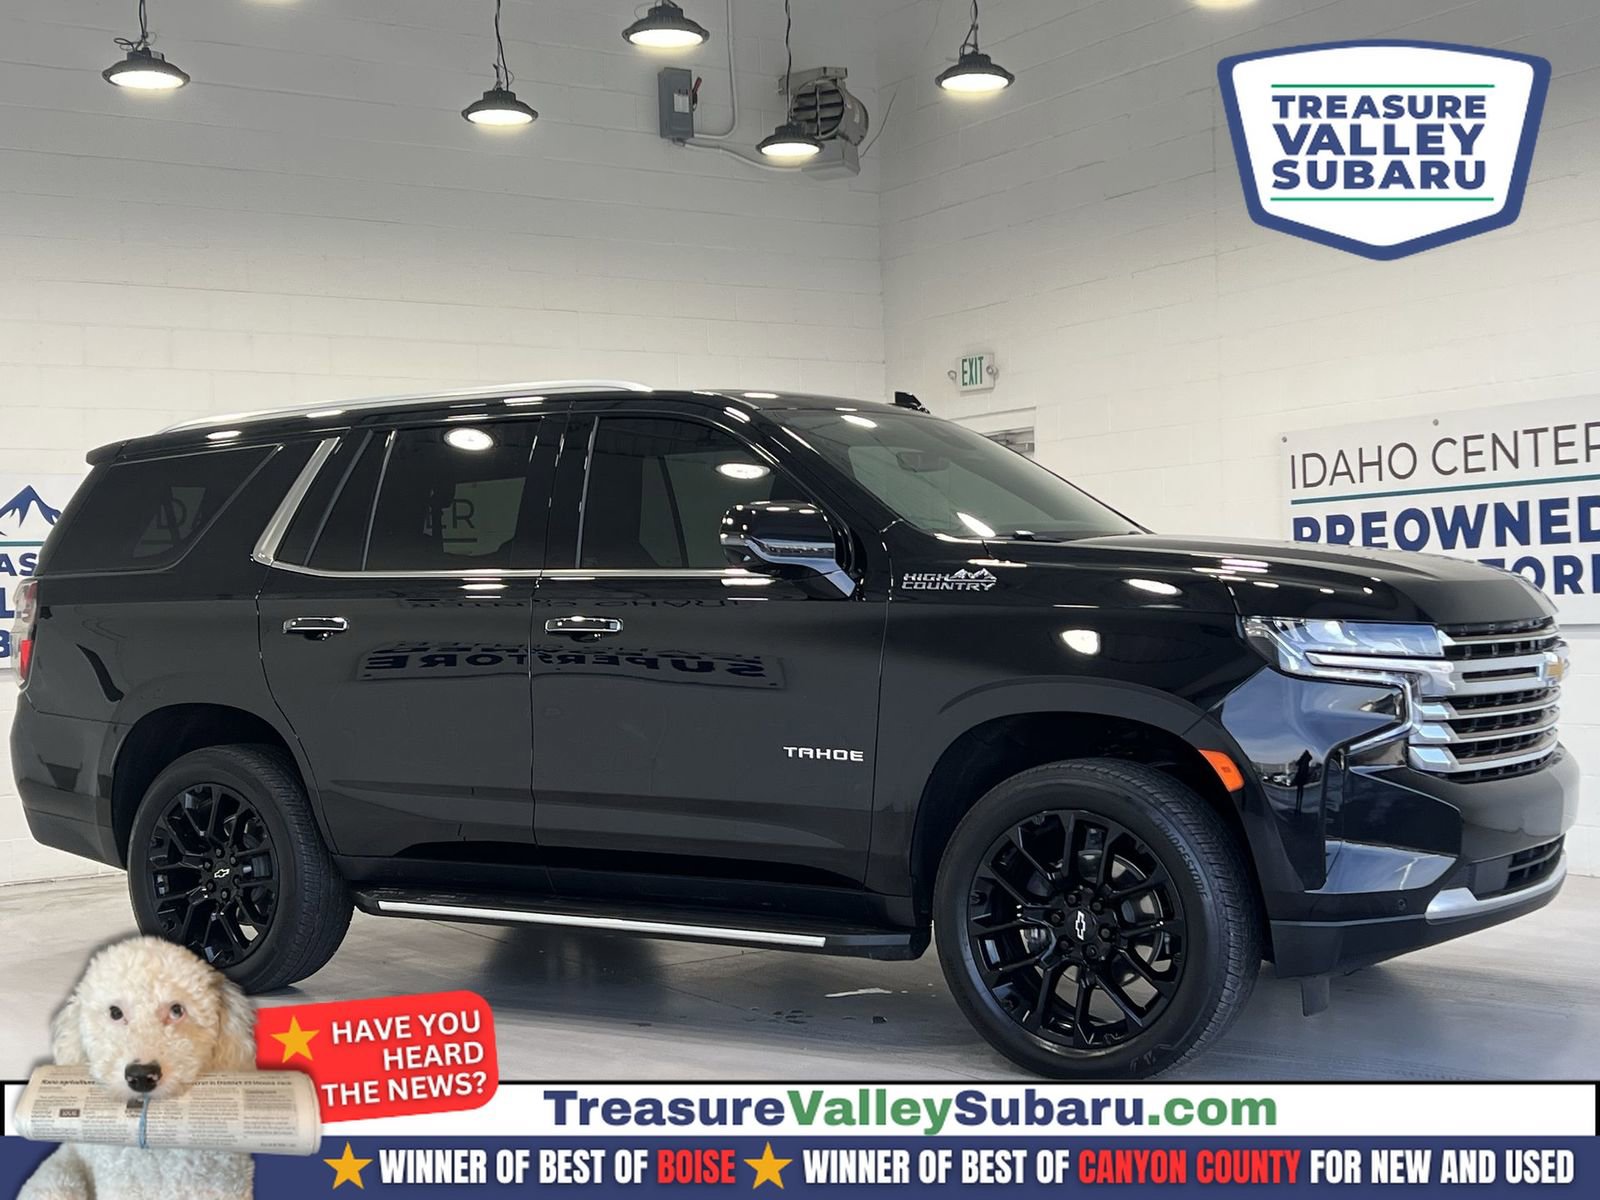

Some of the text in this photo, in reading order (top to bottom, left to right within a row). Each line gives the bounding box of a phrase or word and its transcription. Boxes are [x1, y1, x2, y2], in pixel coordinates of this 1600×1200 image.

[961, 356, 984, 387] EXIT
[1290, 442, 1417, 490] IDAHO
[1293, 494, 1600, 553] PREOWNED
[901, 581, 996, 592] COUNTRY
[903, 573, 951, 582] HIGH
[783, 746, 864, 762] TAHOE
